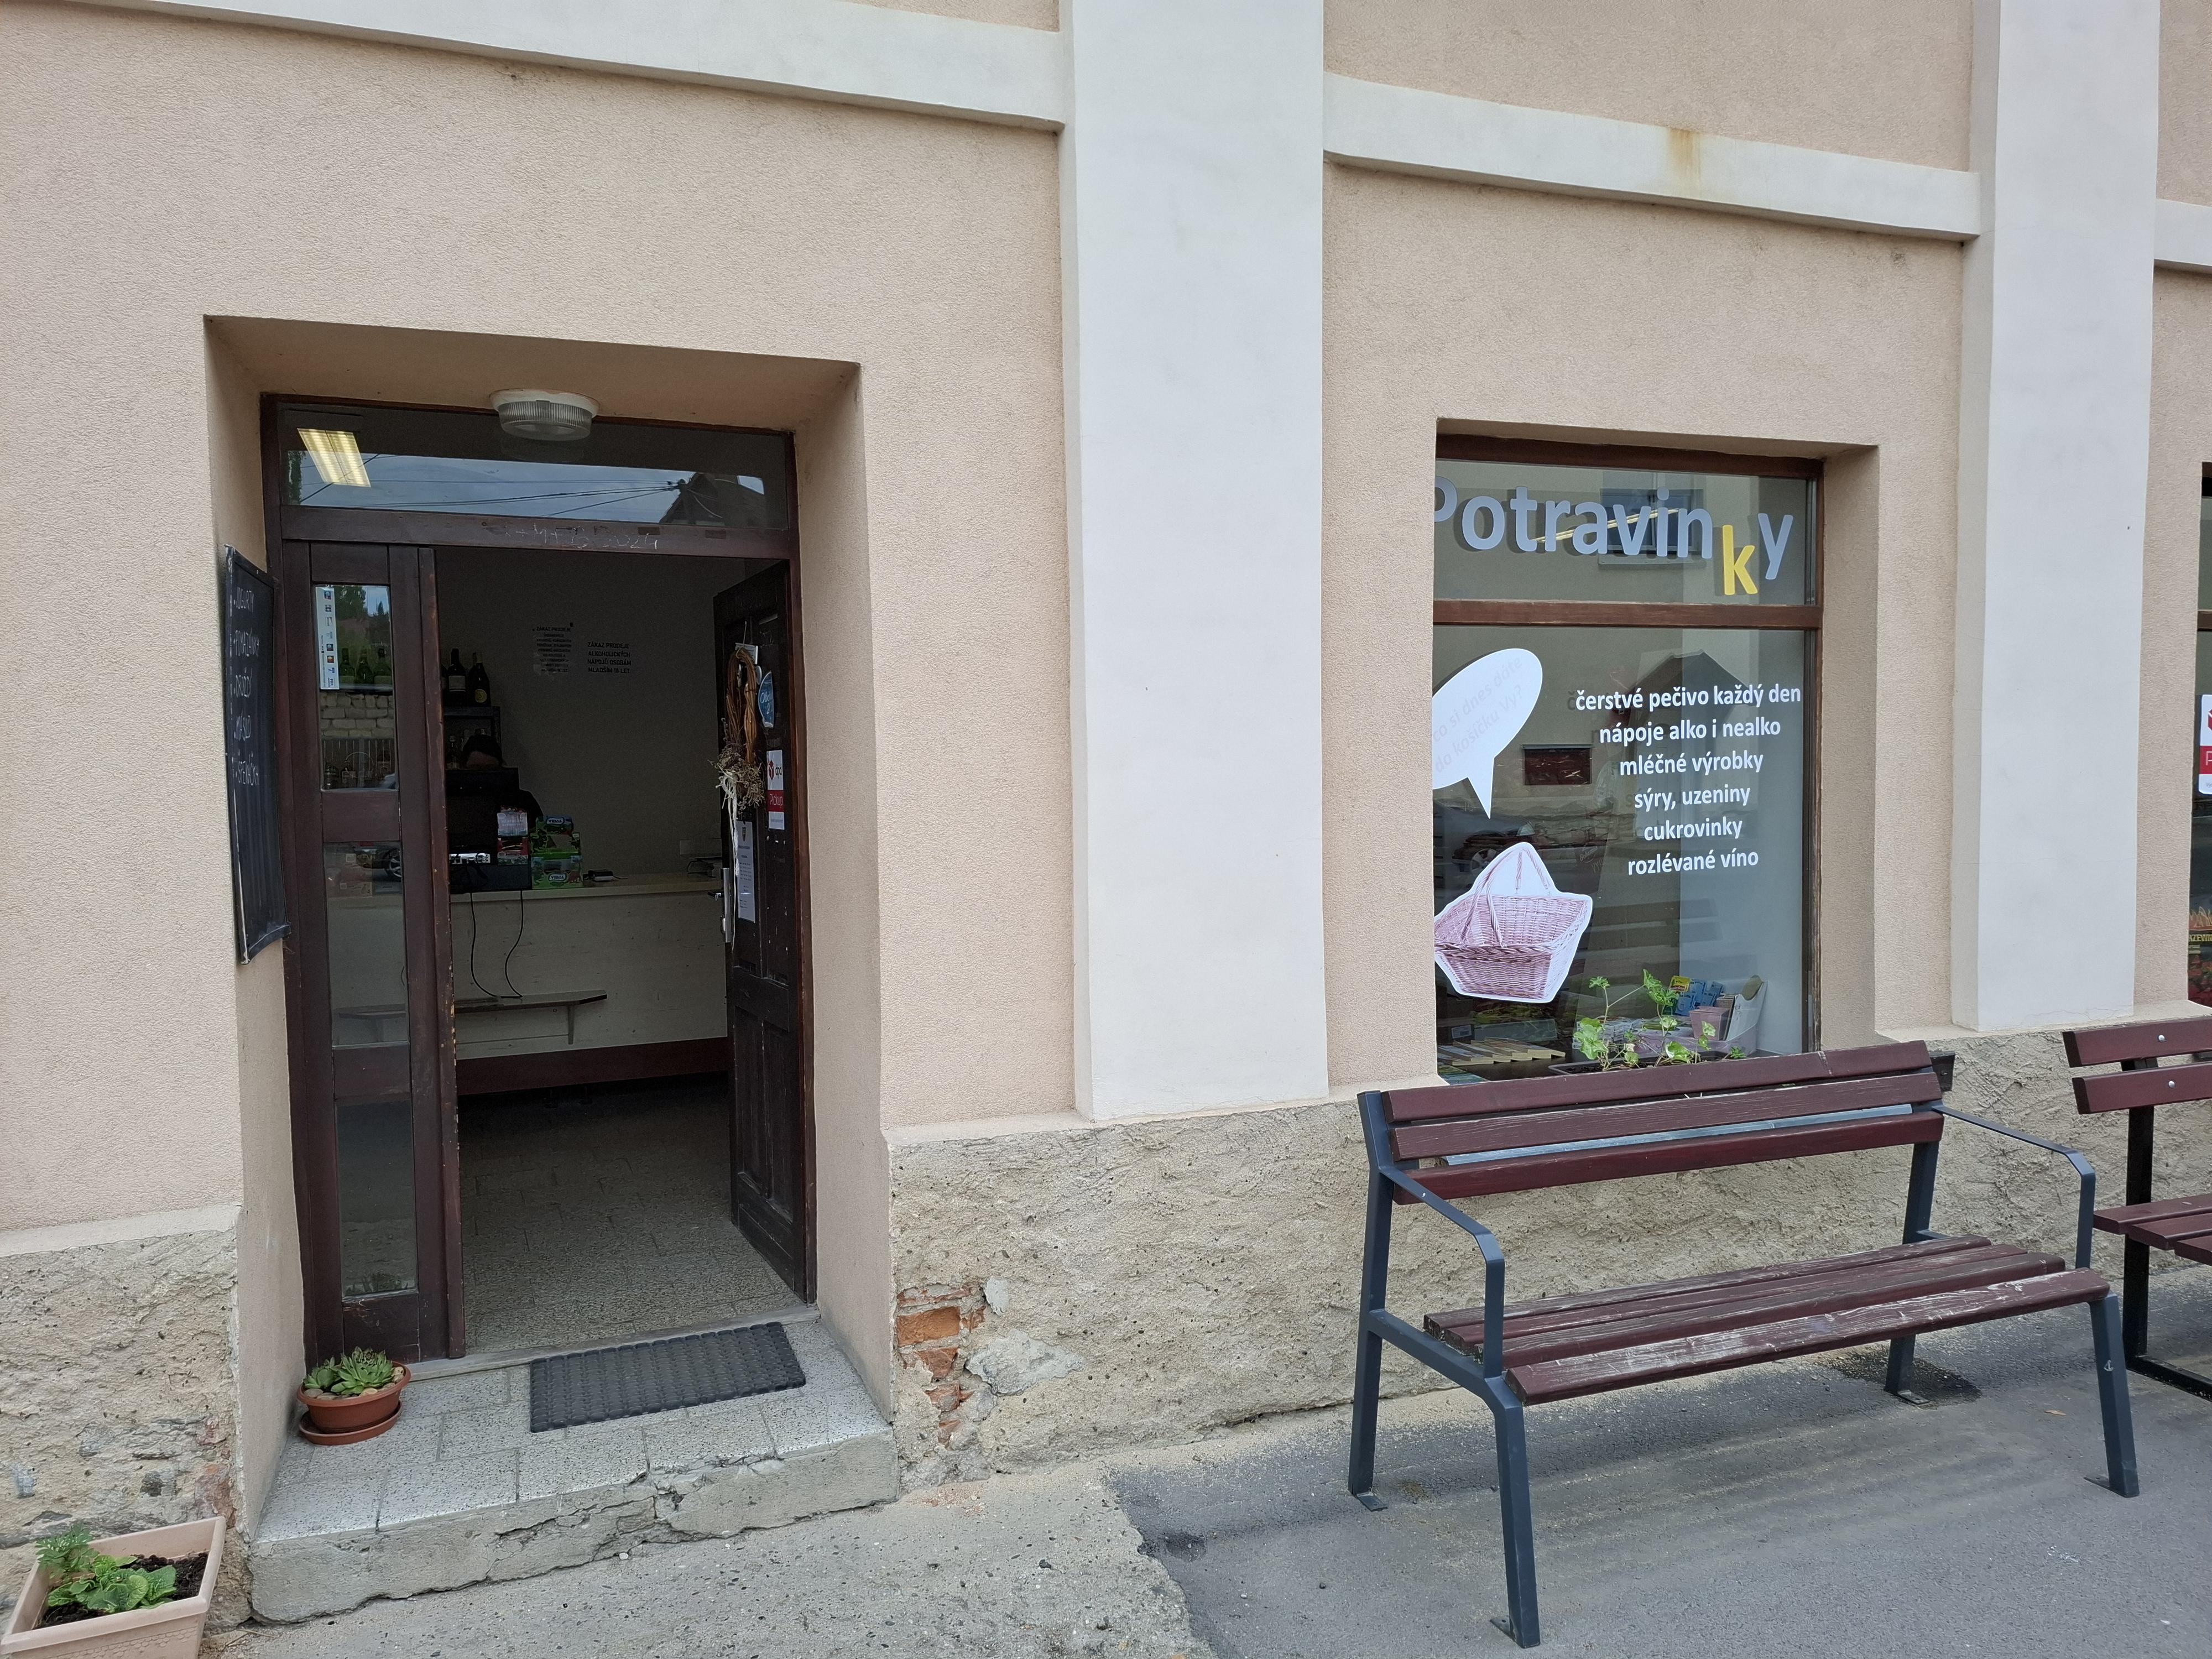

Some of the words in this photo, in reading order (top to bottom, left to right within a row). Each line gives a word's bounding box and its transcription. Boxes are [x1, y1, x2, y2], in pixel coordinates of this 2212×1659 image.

[1576, 688, 1642, 710] čerstvé
[1650, 687, 1708, 712] pečivo
[1714, 684, 1764, 707] každý
[1769, 684, 1800, 702] den
[1433, 724, 1447, 742] co
[1450, 708, 1460, 727] si
[1462, 684, 1492, 715] dnes
[1600, 722, 1663, 747] nápoje
[1670, 720, 1706, 739] alko
[1713, 719, 1716, 737] i
[1723, 717, 1780, 737] nealko
[1435, 754, 1452, 773] do
[1620, 753, 1686, 775] mléčné
[1692, 750, 1763, 775] výrobky
[769, 794, 783, 808] Pickup
[1635, 788, 1676, 812] sýry,
[1683, 784, 1750, 806] uzeniny
[1645, 816, 1742, 840] cukrovinky
[1629, 849, 1715, 875] rozlévané
[1721, 848, 1758, 867] víno
